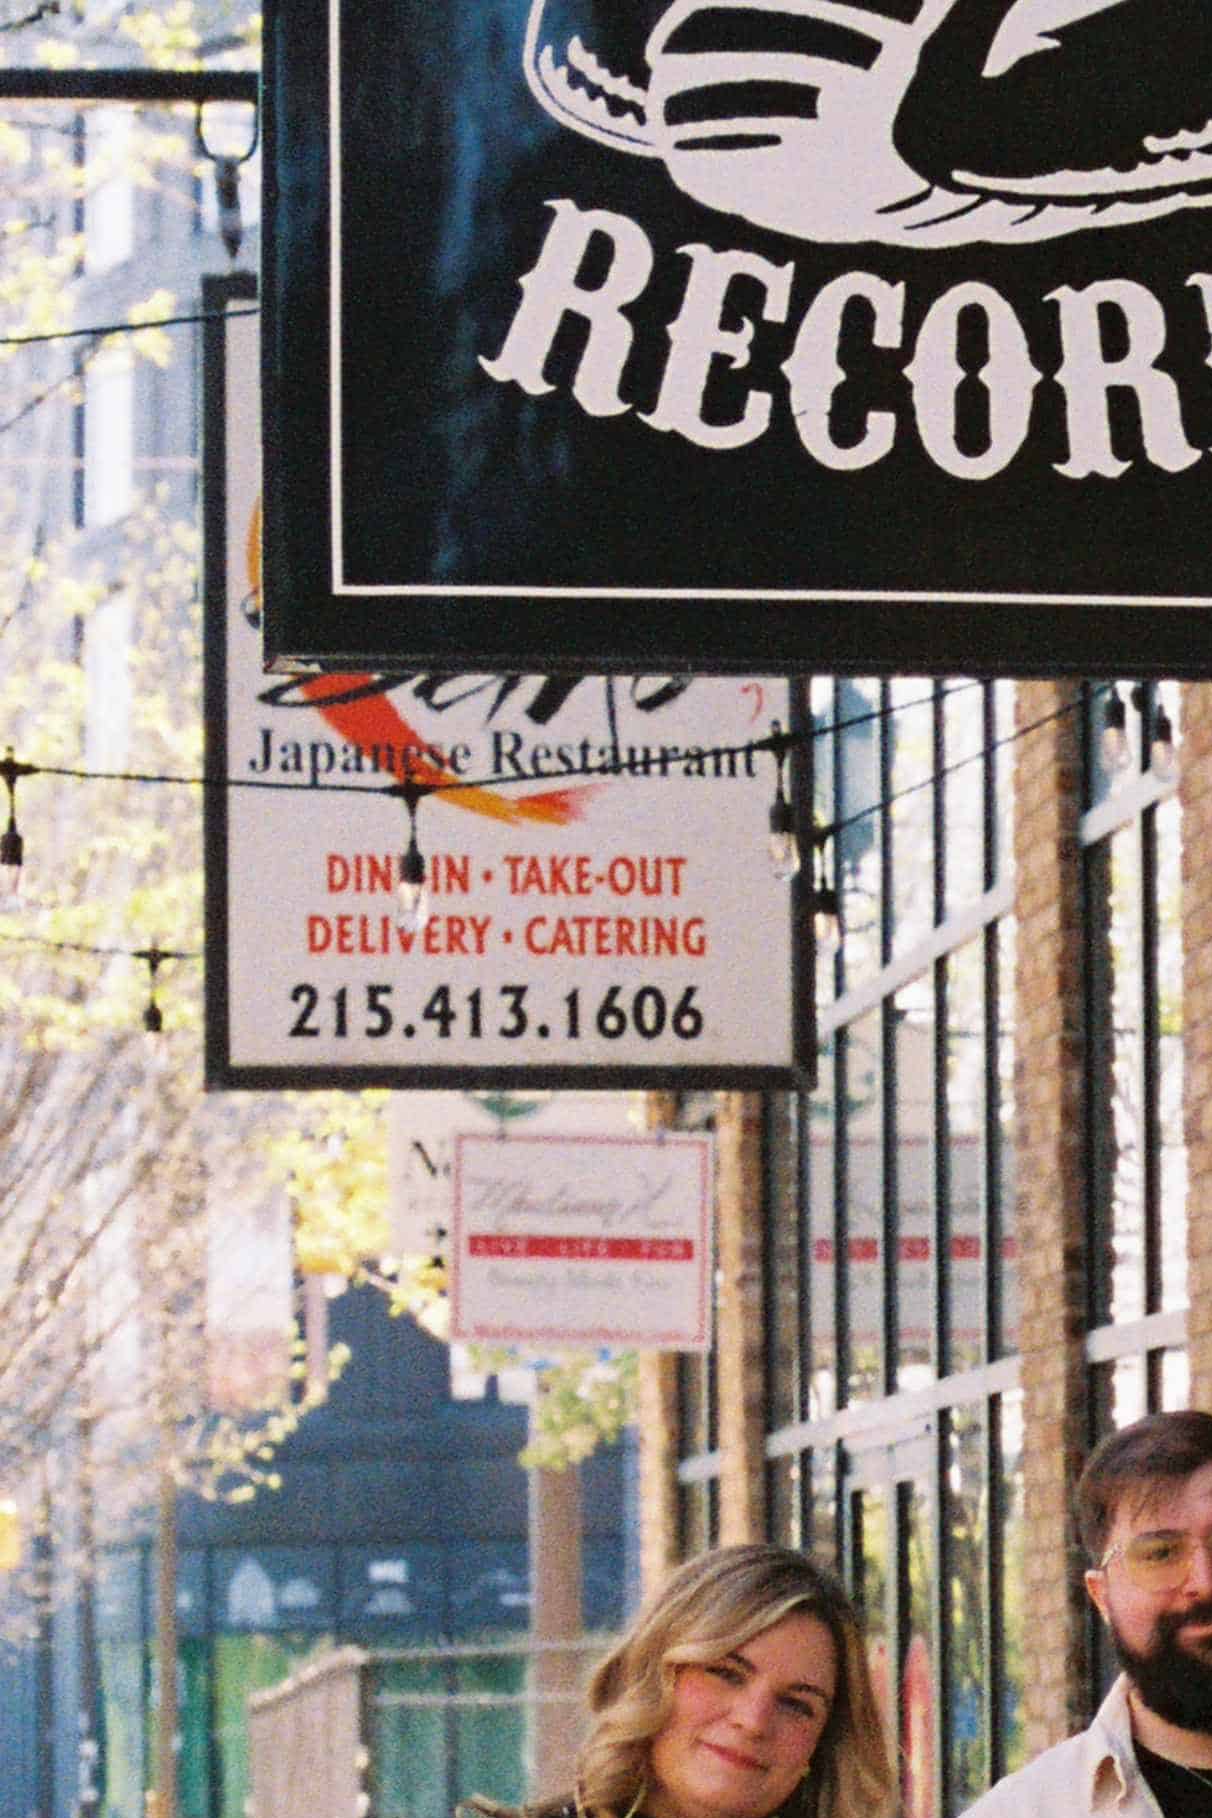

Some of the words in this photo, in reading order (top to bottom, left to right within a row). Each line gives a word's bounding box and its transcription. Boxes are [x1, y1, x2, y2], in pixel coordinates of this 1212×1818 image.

[249, 728, 472, 788] Japanese
[489, 730, 758, 779] Restaurant
[503, 855, 687, 896] TAKE-OUT
[524, 916, 706, 955] CATERING
[289, 983, 705, 1040] 215.413.1606
